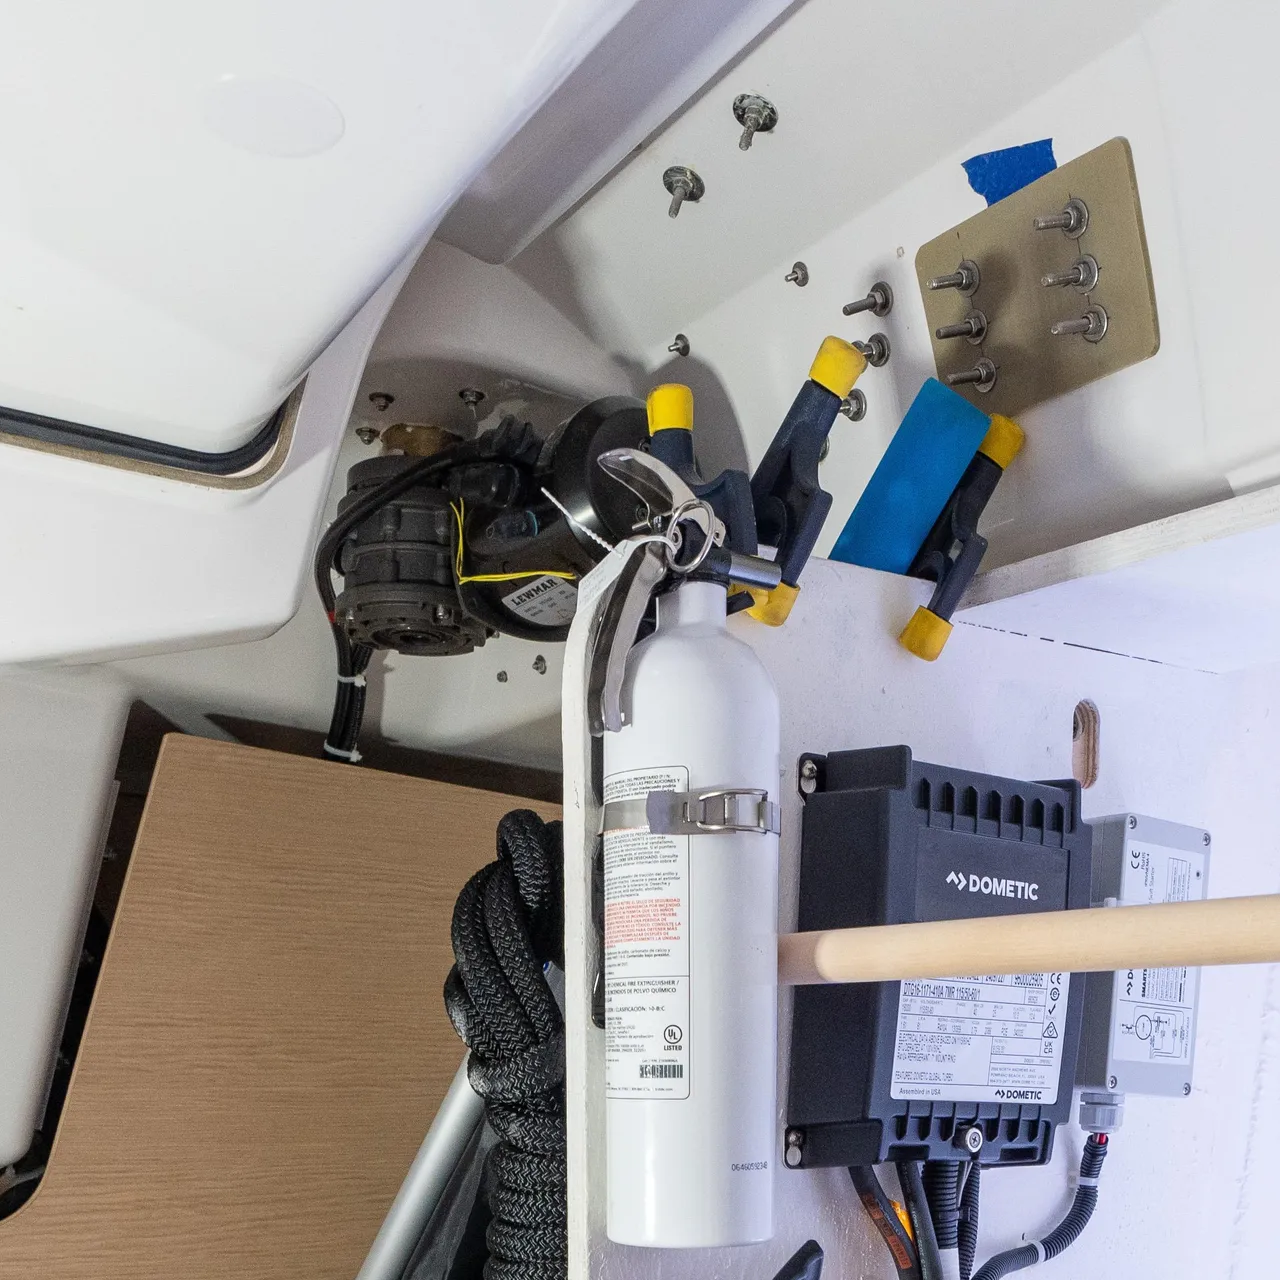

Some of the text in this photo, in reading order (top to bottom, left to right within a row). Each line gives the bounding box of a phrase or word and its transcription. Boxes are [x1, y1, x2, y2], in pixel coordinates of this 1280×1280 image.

[511, 578, 557, 606] LEWMAR
[968, 874, 1039, 901] DOMETIC
[1050, 972, 1062, 985] CE
[899, 1087, 925, 1095] Assembled
[1006, 1089, 1042, 1100] DOMETIC
